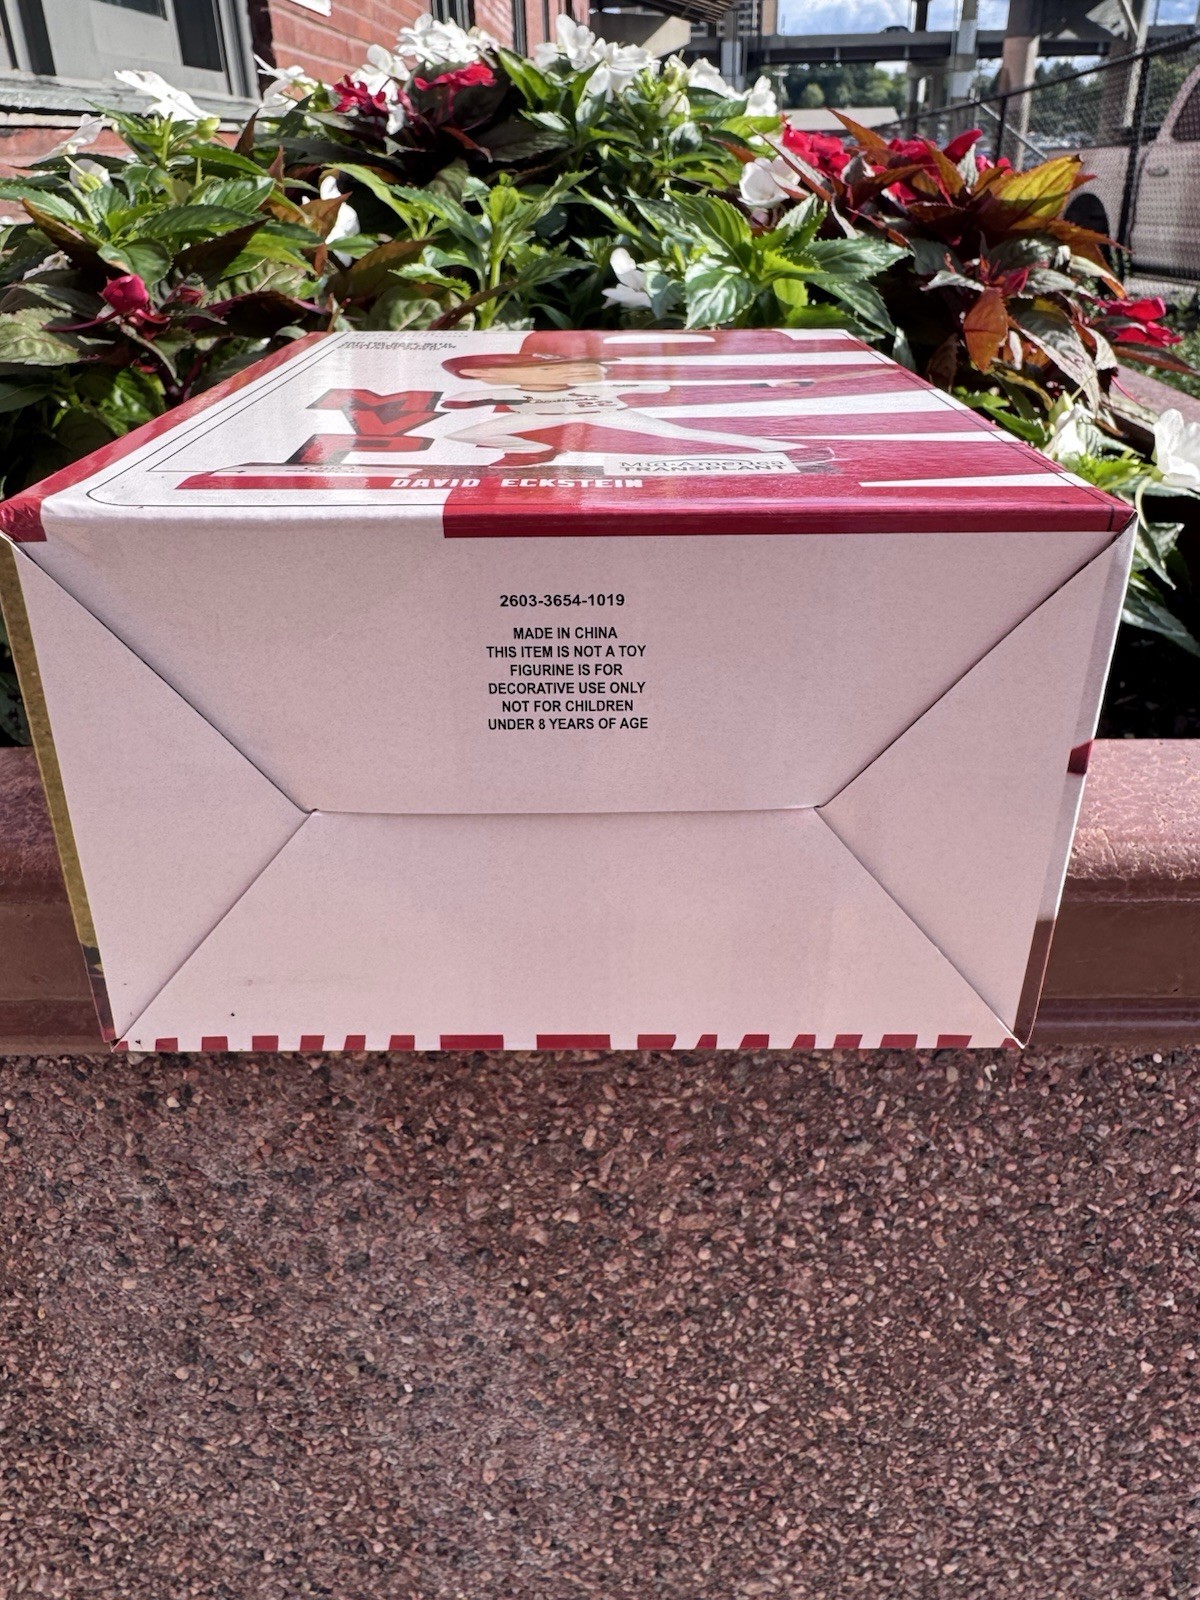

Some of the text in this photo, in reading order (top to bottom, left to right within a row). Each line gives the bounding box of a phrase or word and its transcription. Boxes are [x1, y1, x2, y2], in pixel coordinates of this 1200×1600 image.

[621, 465, 787, 473] TRANSPLANT
[390, 478, 643, 489] DAVID ECKSTEIN
[499, 593, 625, 607] 2603-3654-1019
[513, 626, 618, 640] MADE IN CHINA
[486, 645, 647, 658] THIS ITEM IS NOT A TOY
[510, 663, 623, 676] FIGURINE IS FOR
[488, 681, 646, 694] DECORATIVE USE ONLY
[502, 700, 634, 712] NOT FOR CHILDREN
[488, 717, 649, 730] UNDER 8 YEARS OF AGE
